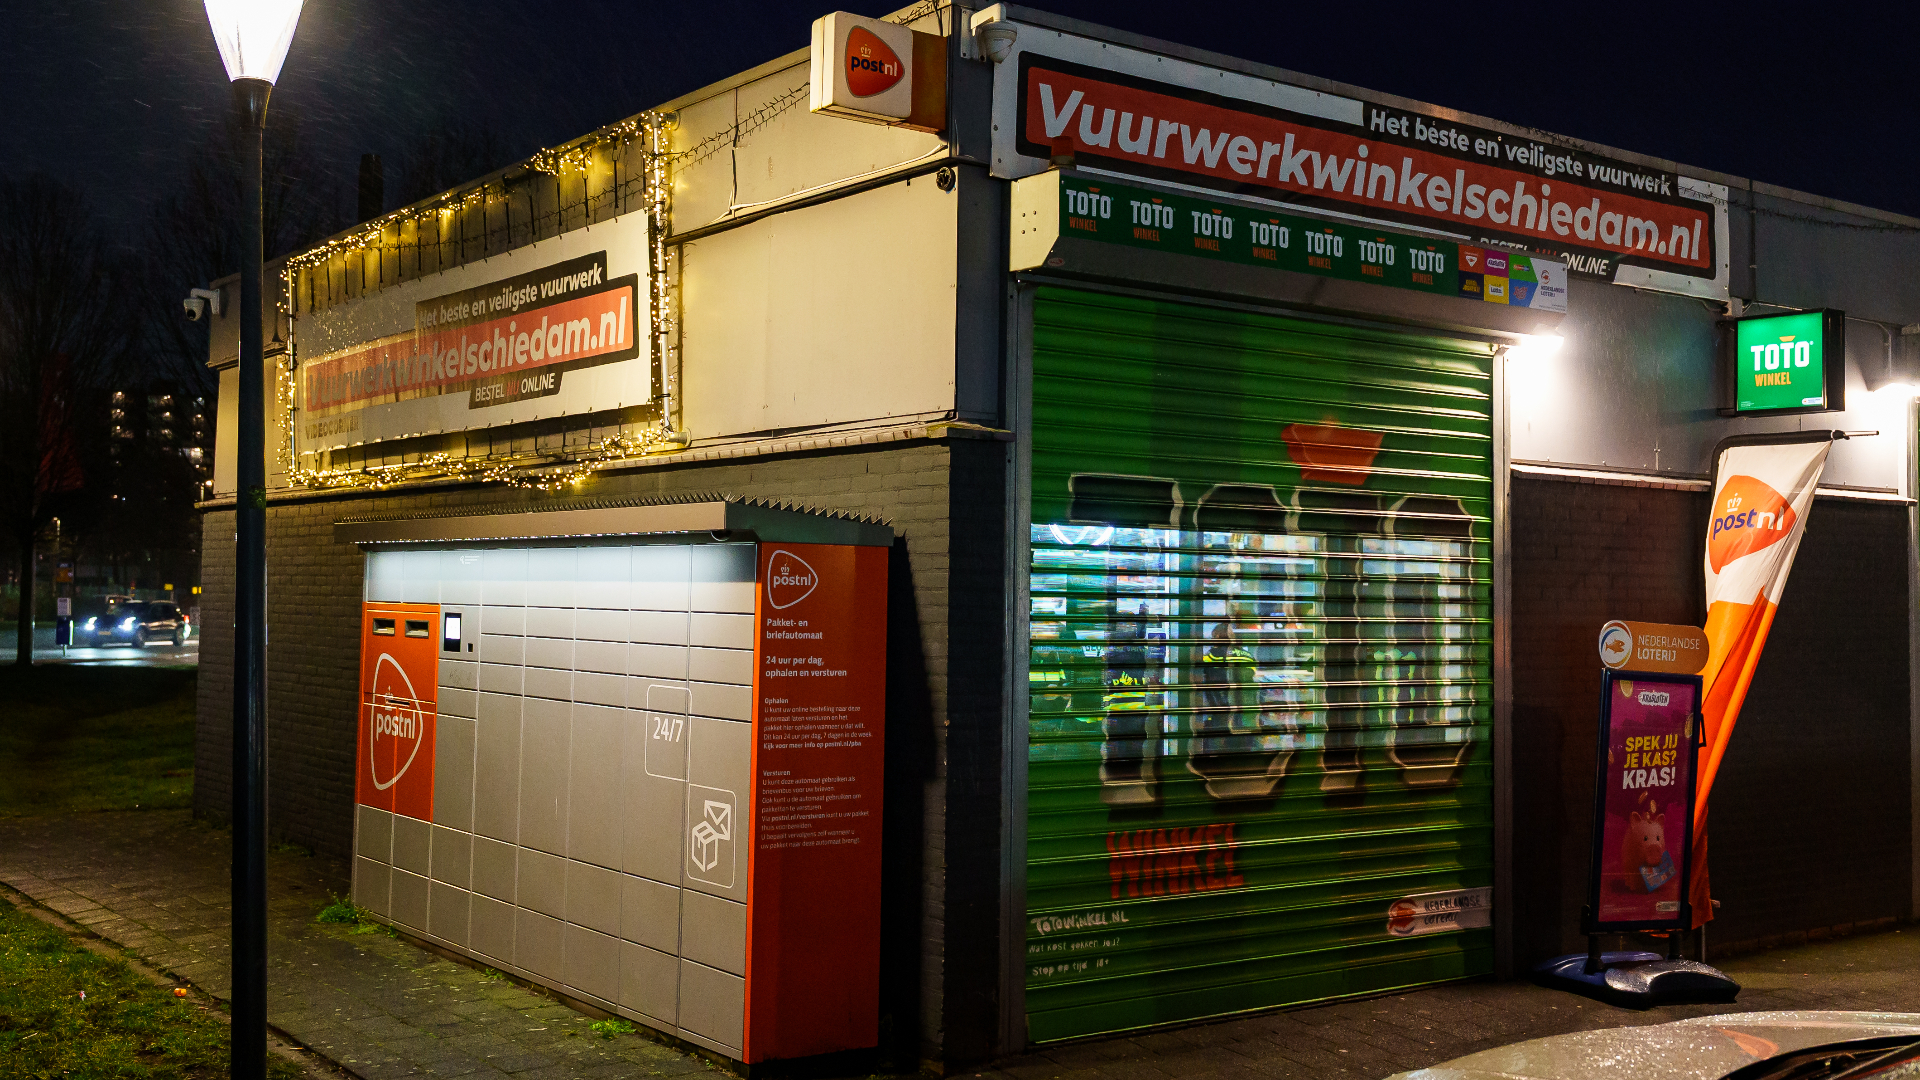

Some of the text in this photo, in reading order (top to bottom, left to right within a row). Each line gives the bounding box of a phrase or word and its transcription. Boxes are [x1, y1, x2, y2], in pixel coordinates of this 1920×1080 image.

[851, 56, 897, 76] postnl
[1370, 108, 1672, 197] Het beste en veiligste vuurwerk
[1038, 82, 1703, 262] Vuurwerkwinkelschiedam.nl
[1066, 189, 1111, 219] TOTO
[1069, 217, 1097, 232] WINKEL
[1130, 200, 1174, 229] TOTO
[1133, 227, 1160, 242] WINKEL
[1192, 211, 1233, 239] TOTO
[1250, 221, 1289, 248] TOTO
[1194, 237, 1220, 251] WINKEL
[1253, 247, 1277, 261] WINKEL
[1305, 231, 1343, 257] TOTO
[1359, 240, 1395, 266] TOTO
[1308, 256, 1331, 270] WINKEL
[1361, 264, 1383, 277] WINKEL
[1410, 248, 1444, 274] TOTO
[1412, 272, 1433, 285] WINKEL
[440, 305, 469, 324] beste
[472, 300, 486, 317] en
[489, 284, 538, 312] veiligste
[541, 263, 602, 298] vuurwerk
[308, 295, 627, 407] Vuurwerkwinkelschiedam.nl
[1751, 341, 1810, 371] TOTO
[474, 382, 506, 402] BESTEL
[521, 372, 555, 394] ONLINE
[1755, 371, 1791, 387] WINKEL
[1713, 505, 1784, 541] postnl
[773, 574, 811, 588] postnl
[767, 618, 797, 626] Pakket-
[767, 631, 822, 639] briefautomaat
[1638, 635, 1700, 650] NEDERLANDSE
[766, 656, 776, 664] 24
[793, 657, 806, 666] per
[808, 656, 824, 666] dag,
[1638, 648, 1676, 661] LOTERIJ
[766, 669, 797, 678] ophalen
[811, 669, 847, 677] versturen
[376, 710, 415, 741] postnl
[652, 716, 684, 743] 24/7
[1626, 734, 1678, 752] SPEK JIJ
[1624, 750, 1677, 768] JE KAS?
[1622, 767, 1675, 789] KRAS!
[1106, 823, 1244, 899] WINKEL
[1032, 966, 1054, 976] Stop
[1057, 964, 1069, 973] op
[1072, 961, 1087, 972] tijd
